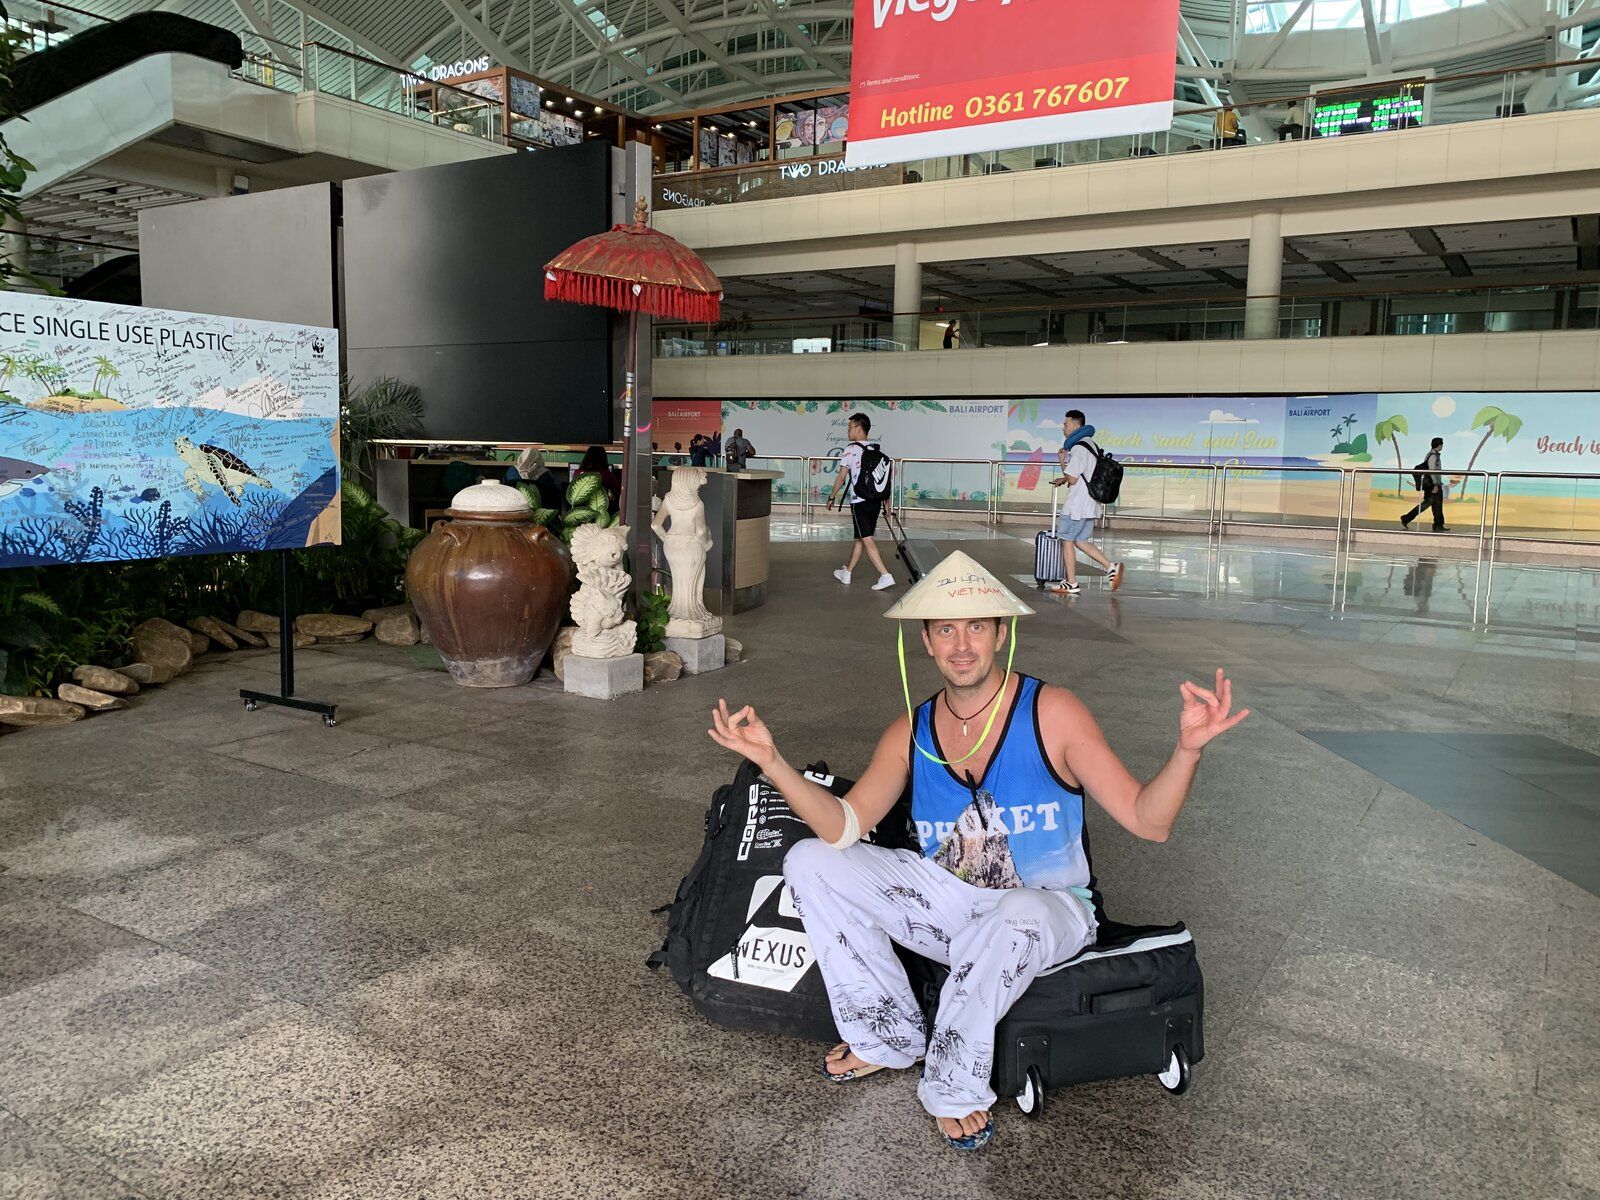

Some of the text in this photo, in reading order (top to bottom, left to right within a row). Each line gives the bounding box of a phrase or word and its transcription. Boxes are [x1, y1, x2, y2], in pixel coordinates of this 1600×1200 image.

[400, 56, 489, 88] TWO DRAGONS
[880, 77, 1130, 129] Hotline 0361 767607
[779, 163, 811, 180] TWO
[33, 315, 110, 341] SINGLE
[116, 324, 154, 346] USE
[160, 328, 233, 352] PLASTIC
[949, 405, 1004, 414] BALI AIRPORT
[1288, 408, 1331, 417] BALI AIRPORT
[1537, 435, 1589, 456] Beach
